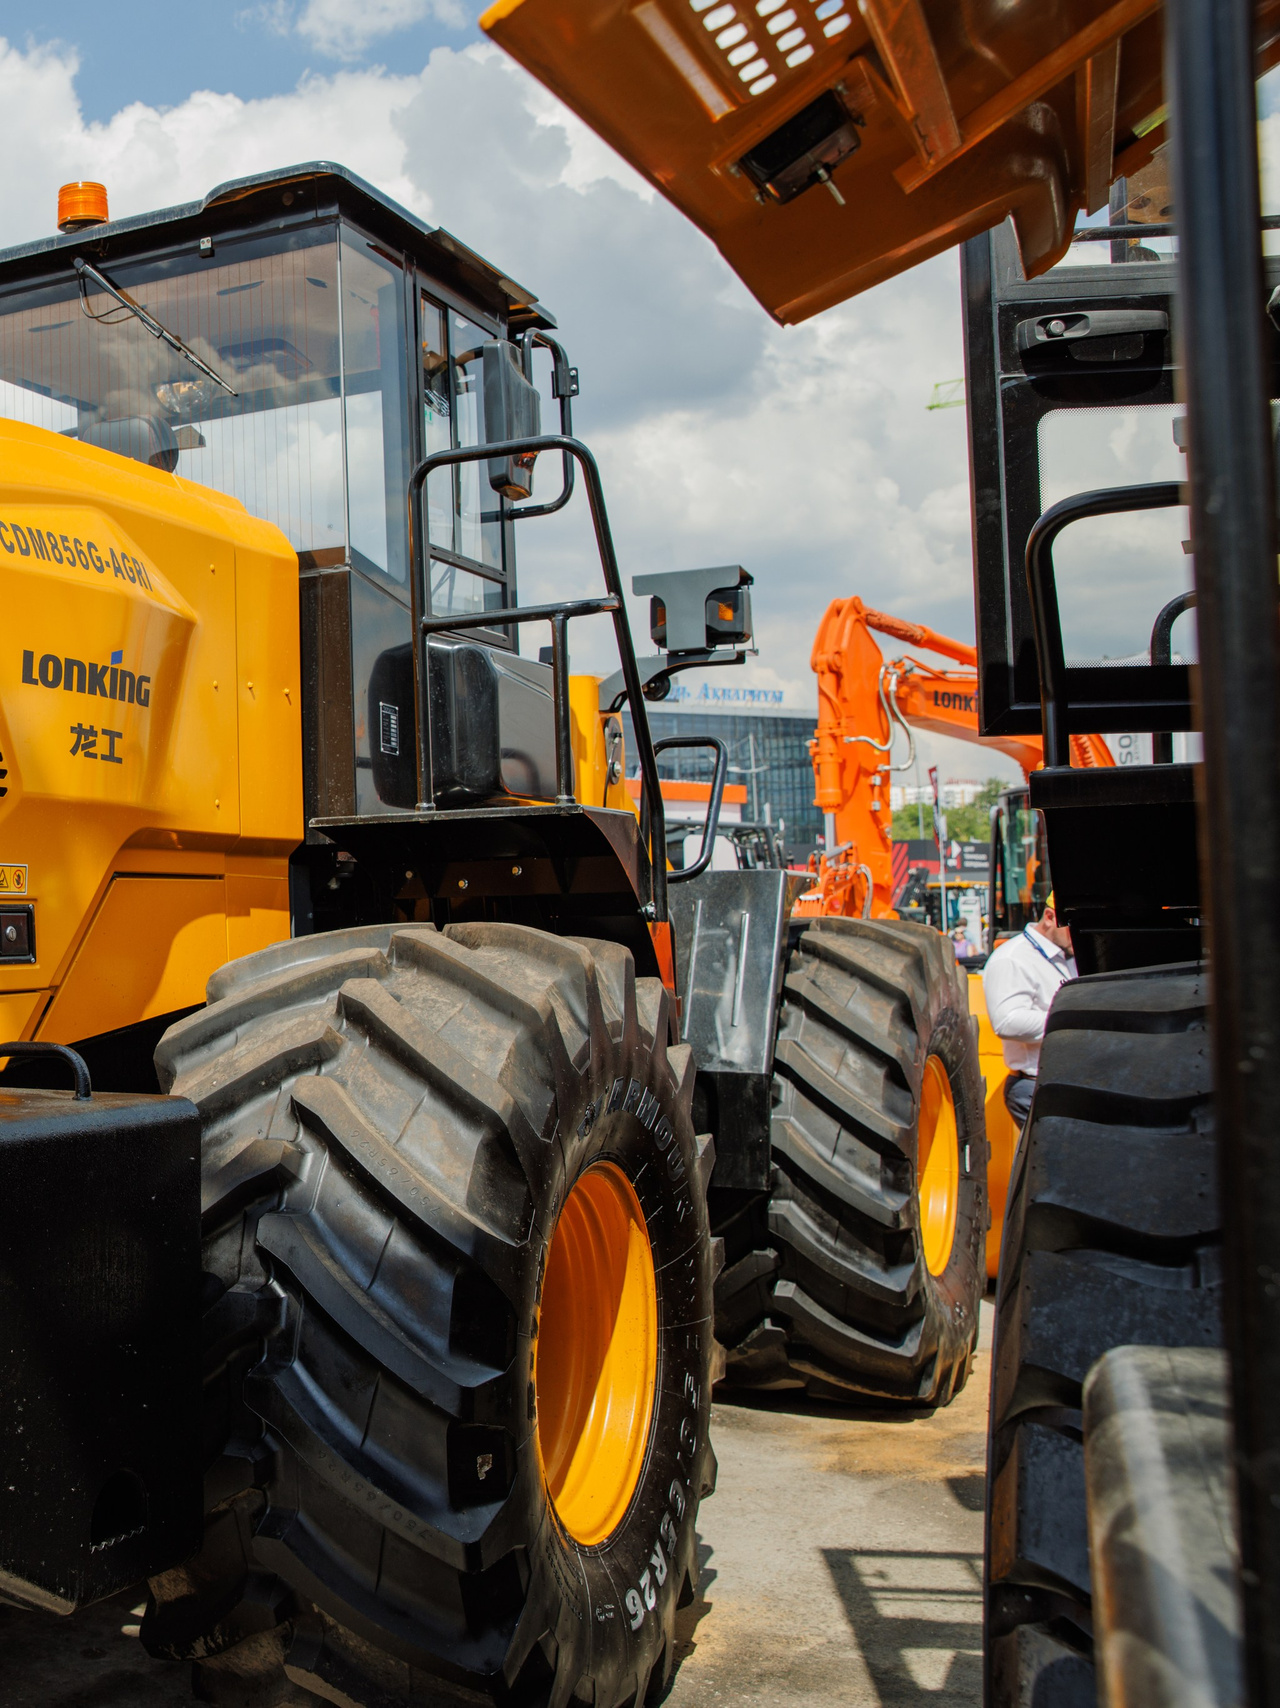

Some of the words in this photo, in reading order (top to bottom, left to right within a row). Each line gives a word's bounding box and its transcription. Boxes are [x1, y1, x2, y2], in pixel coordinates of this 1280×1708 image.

[21, 649, 151, 708] LONKING
[933, 689, 979, 713] LONKI
[69, 722, 123, 765] 龙工
